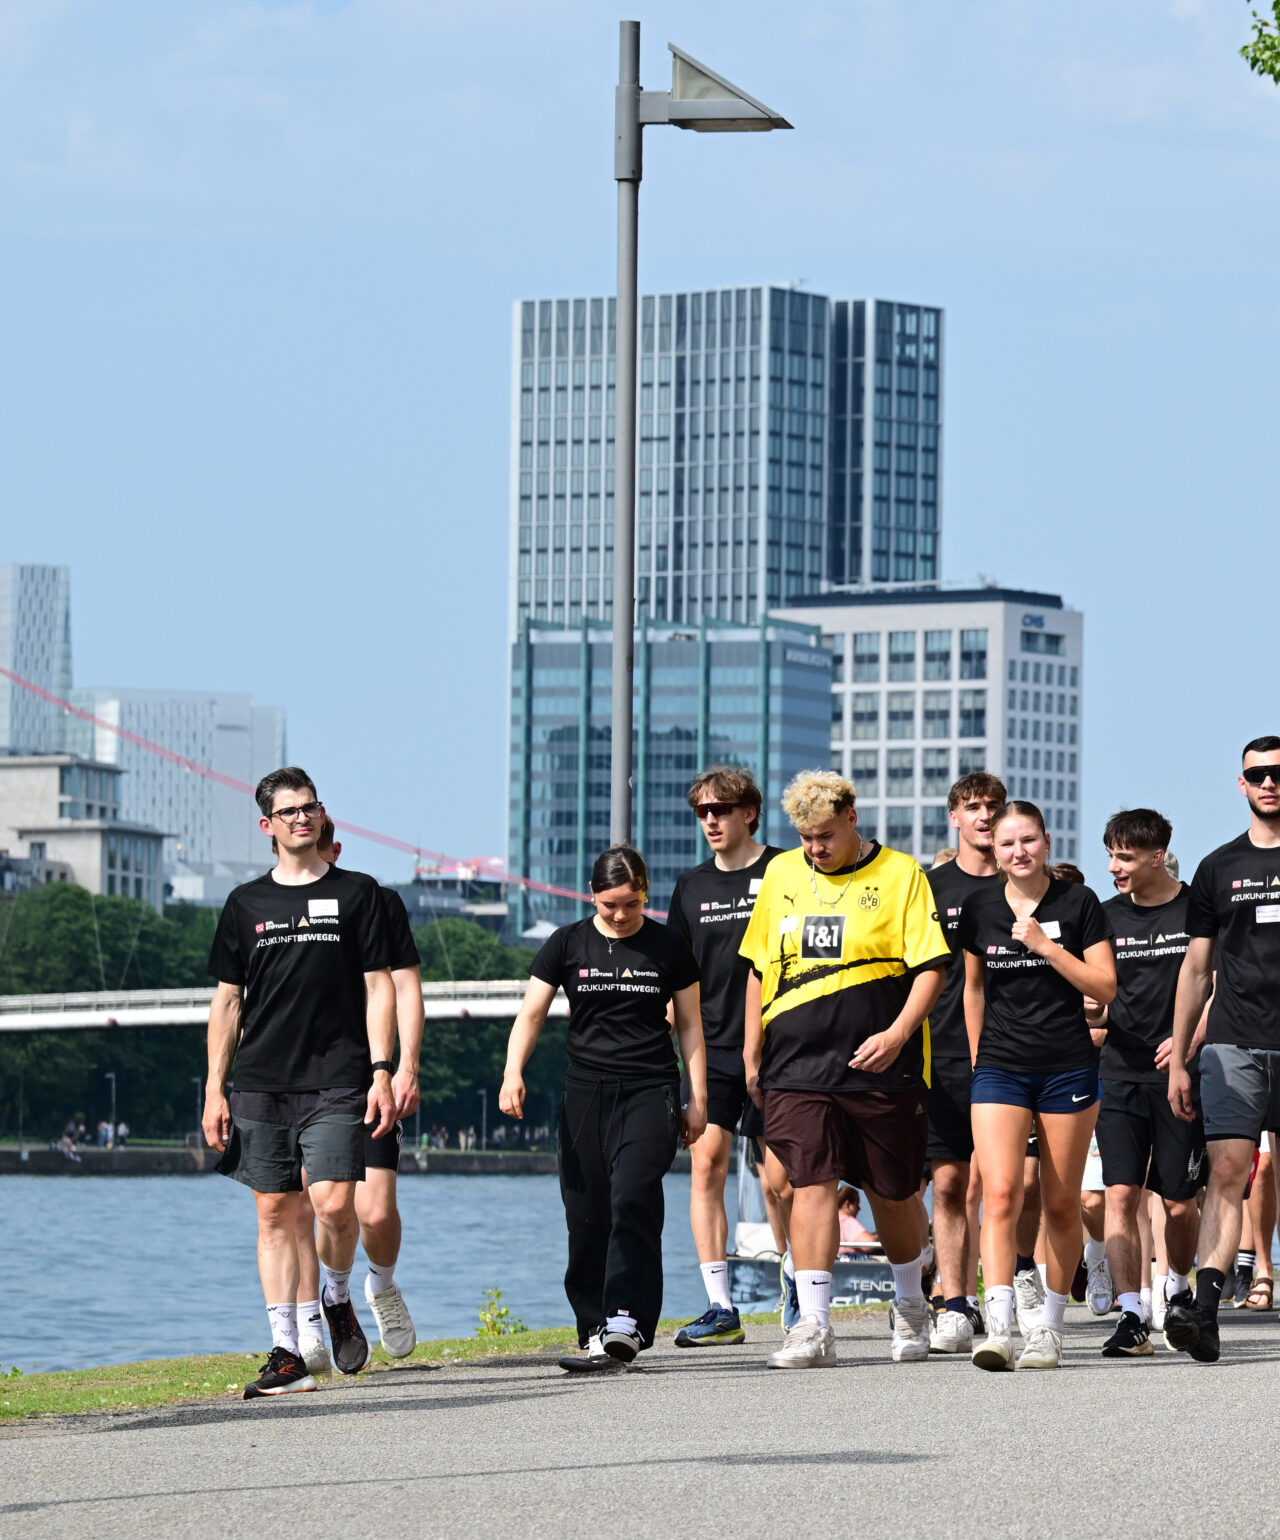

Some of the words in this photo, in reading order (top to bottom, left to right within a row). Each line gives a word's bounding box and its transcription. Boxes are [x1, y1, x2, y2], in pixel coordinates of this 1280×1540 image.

[700, 911, 754, 923] #ZUKUNFTBEW
[806, 925, 839, 948] 1&1
[577, 984, 660, 994] #ZUKUNFTBEWEGEN
[850, 1279, 896, 1292] TEND
